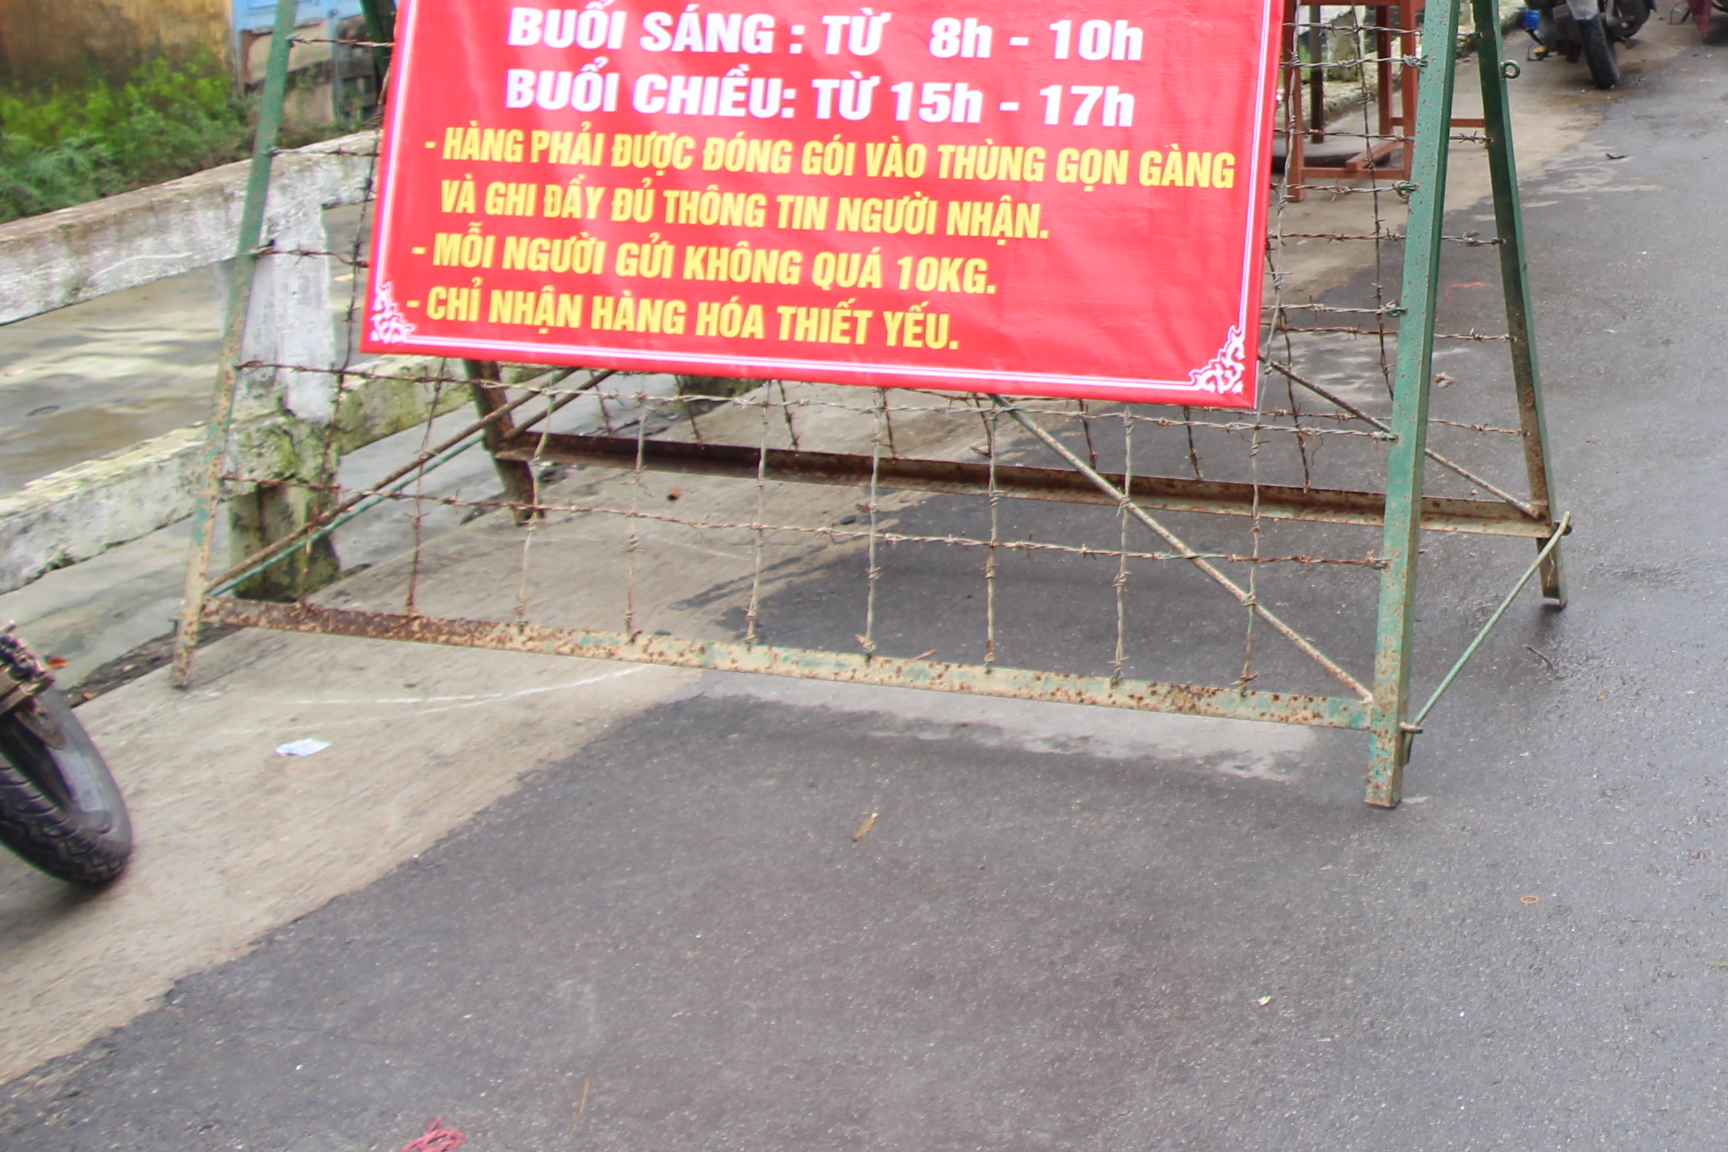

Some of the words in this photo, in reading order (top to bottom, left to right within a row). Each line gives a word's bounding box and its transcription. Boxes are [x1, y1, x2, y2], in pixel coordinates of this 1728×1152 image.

[641, 5, 775, 53] SÁNG
[822, 9, 891, 55] TỪ
[929, 18, 992, 58] 8h
[1049, 20, 1144, 61] 10h
[506, 57, 619, 112] BUỔI
[632, 64, 797, 118] CHIỀU:
[812, 72, 880, 120] TỪ
[890, 81, 984, 124] 15h
[1039, 85, 1135, 127] 17h
[442, 121, 524, 163] HÀNG
[531, 122, 602, 165] PHẢI
[611, 134, 694, 175] ĐƯỢC
[703, 131, 792, 174] ĐÓNG
[802, 136, 855, 176] GÓI
[865, 137, 927, 178] VÀO
[937, 139, 1045, 181] THÙNG
[1056, 149, 1129, 192] GỌN
[1139, 144, 1235, 188] GÀNG
[441, 174, 475, 214] VÀ
[484, 182, 537, 217] GHI
[543, 174, 604, 219] ĐẦY
[611, 178, 656, 222] ĐỦ
[663, 185, 766, 228] THÔNG
[777, 195, 828, 231] TIN
[836, 191, 937, 235] NGƯỜI
[946, 195, 1049, 245] NHẬN.
[433, 222, 495, 268] MỖI
[502, 233, 606, 275] NGƯỜI
[615, 233, 675, 279] GỬI
[683, 241, 802, 285] KHÔNG
[811, 247, 882, 291] QUÁ
[897, 256, 996, 295] 10KG.
[426, 277, 482, 321] CHỈ
[489, 286, 583, 334] NHẬN
[591, 290, 686, 335] HÀNG
[695, 295, 765, 339] HÓA
[777, 298, 873, 345] THIẾT
[883, 298, 958, 350] YẾU.
